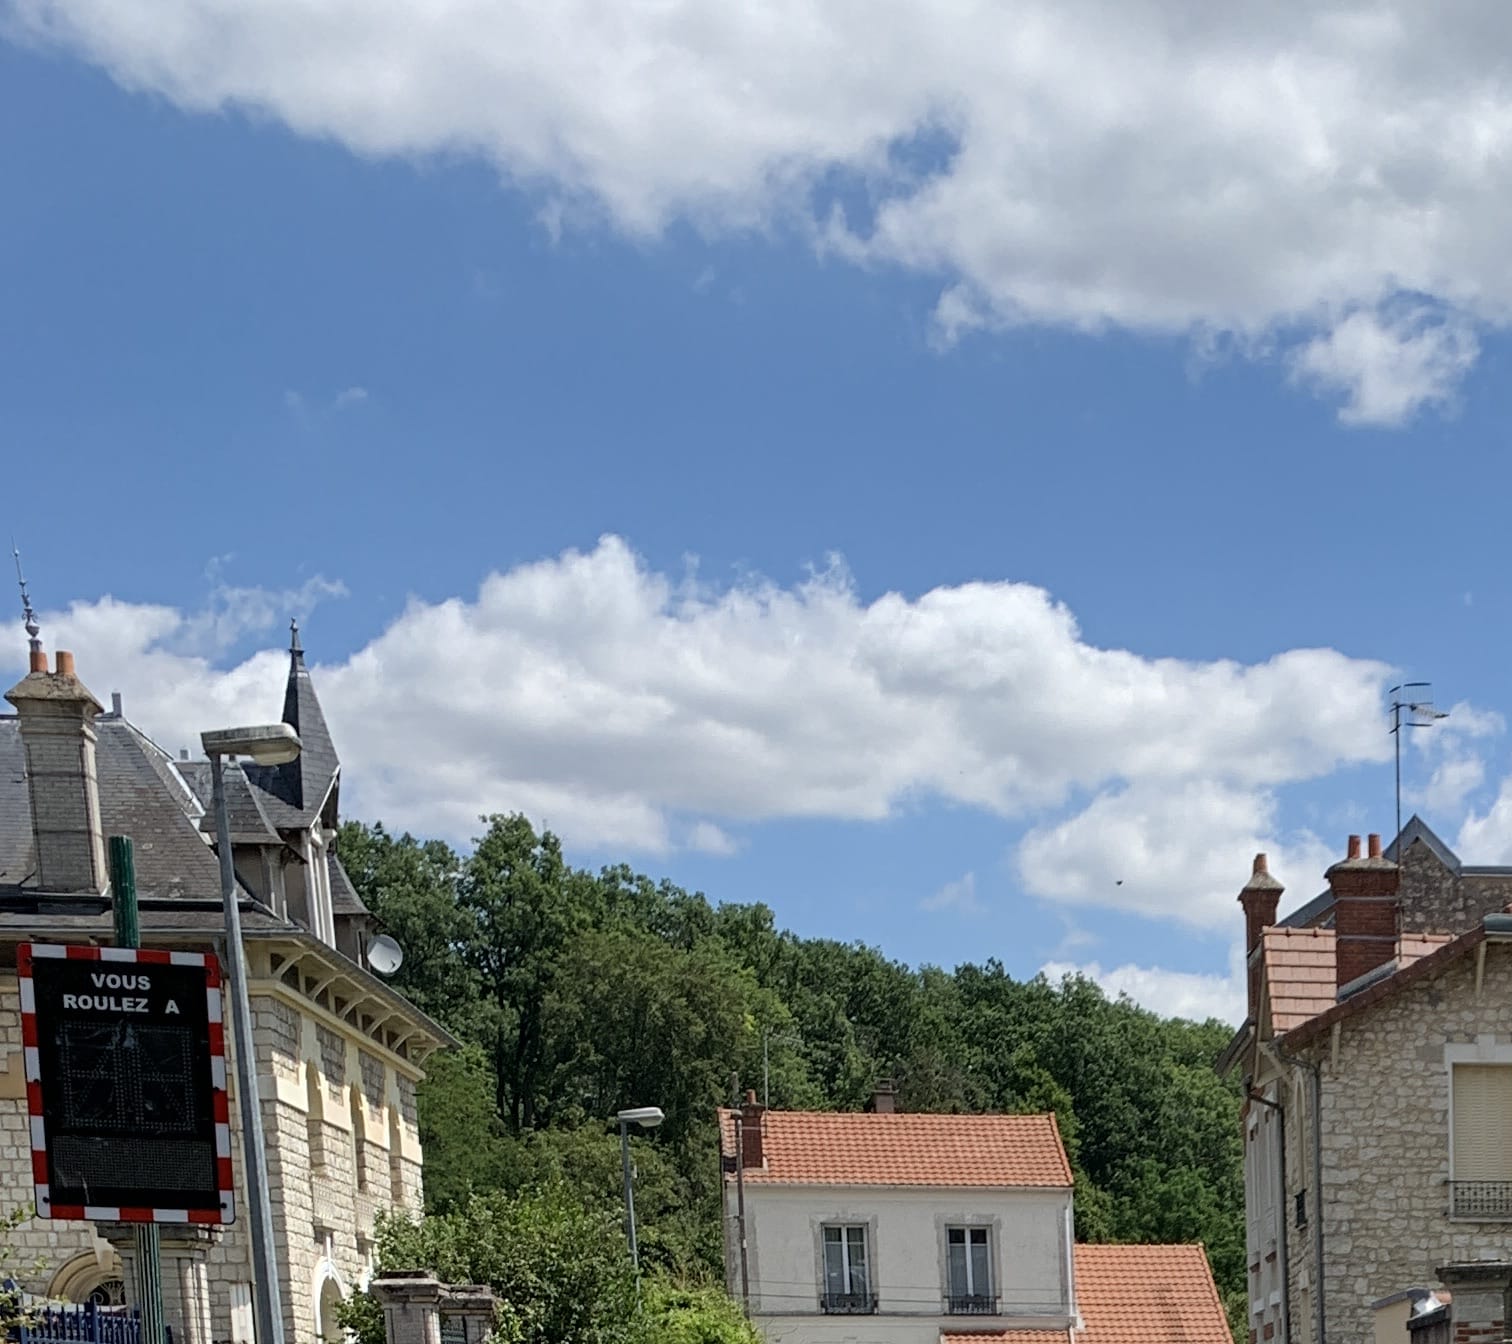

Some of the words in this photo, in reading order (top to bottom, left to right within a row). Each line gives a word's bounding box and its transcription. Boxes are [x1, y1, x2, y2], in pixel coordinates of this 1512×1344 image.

[90, 973, 152, 990] VOUS
[63, 994, 149, 1013] ROULEZ
[165, 999, 180, 1014] A
